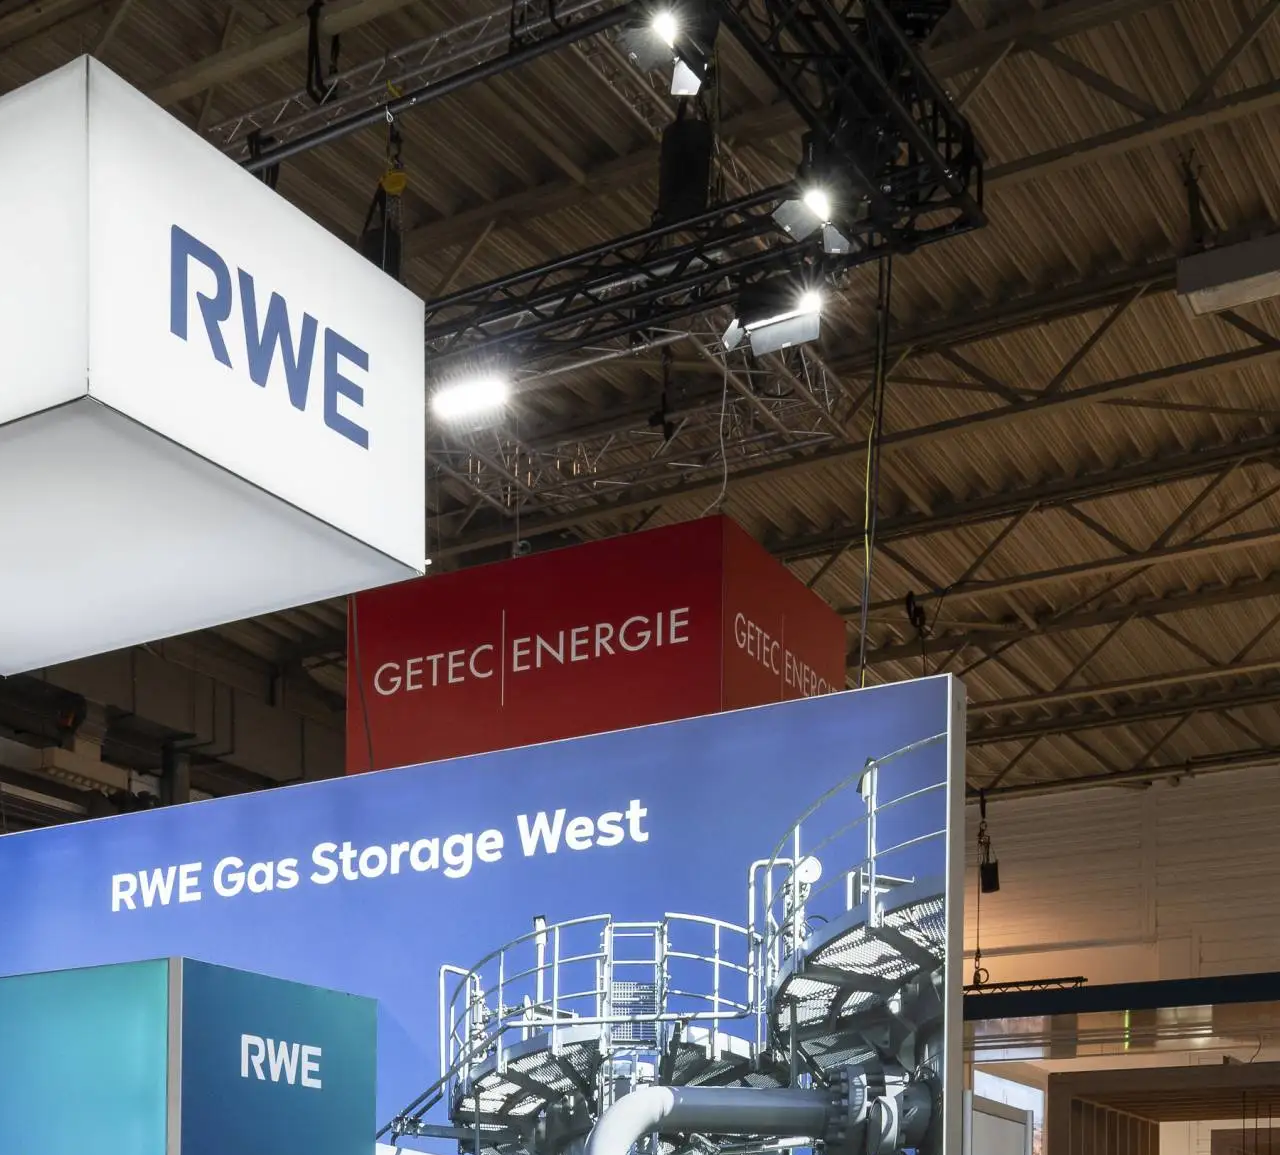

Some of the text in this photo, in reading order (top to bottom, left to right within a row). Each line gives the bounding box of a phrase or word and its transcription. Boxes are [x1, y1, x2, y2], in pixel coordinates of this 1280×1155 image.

[170, 223, 371, 451] RWE
[373, 607, 690, 697] GETEC ENERGIE
[734, 612, 780, 675] GETEC
[110, 798, 650, 913] RWE Gas Storage West
[240, 1033, 323, 1090] RWE
